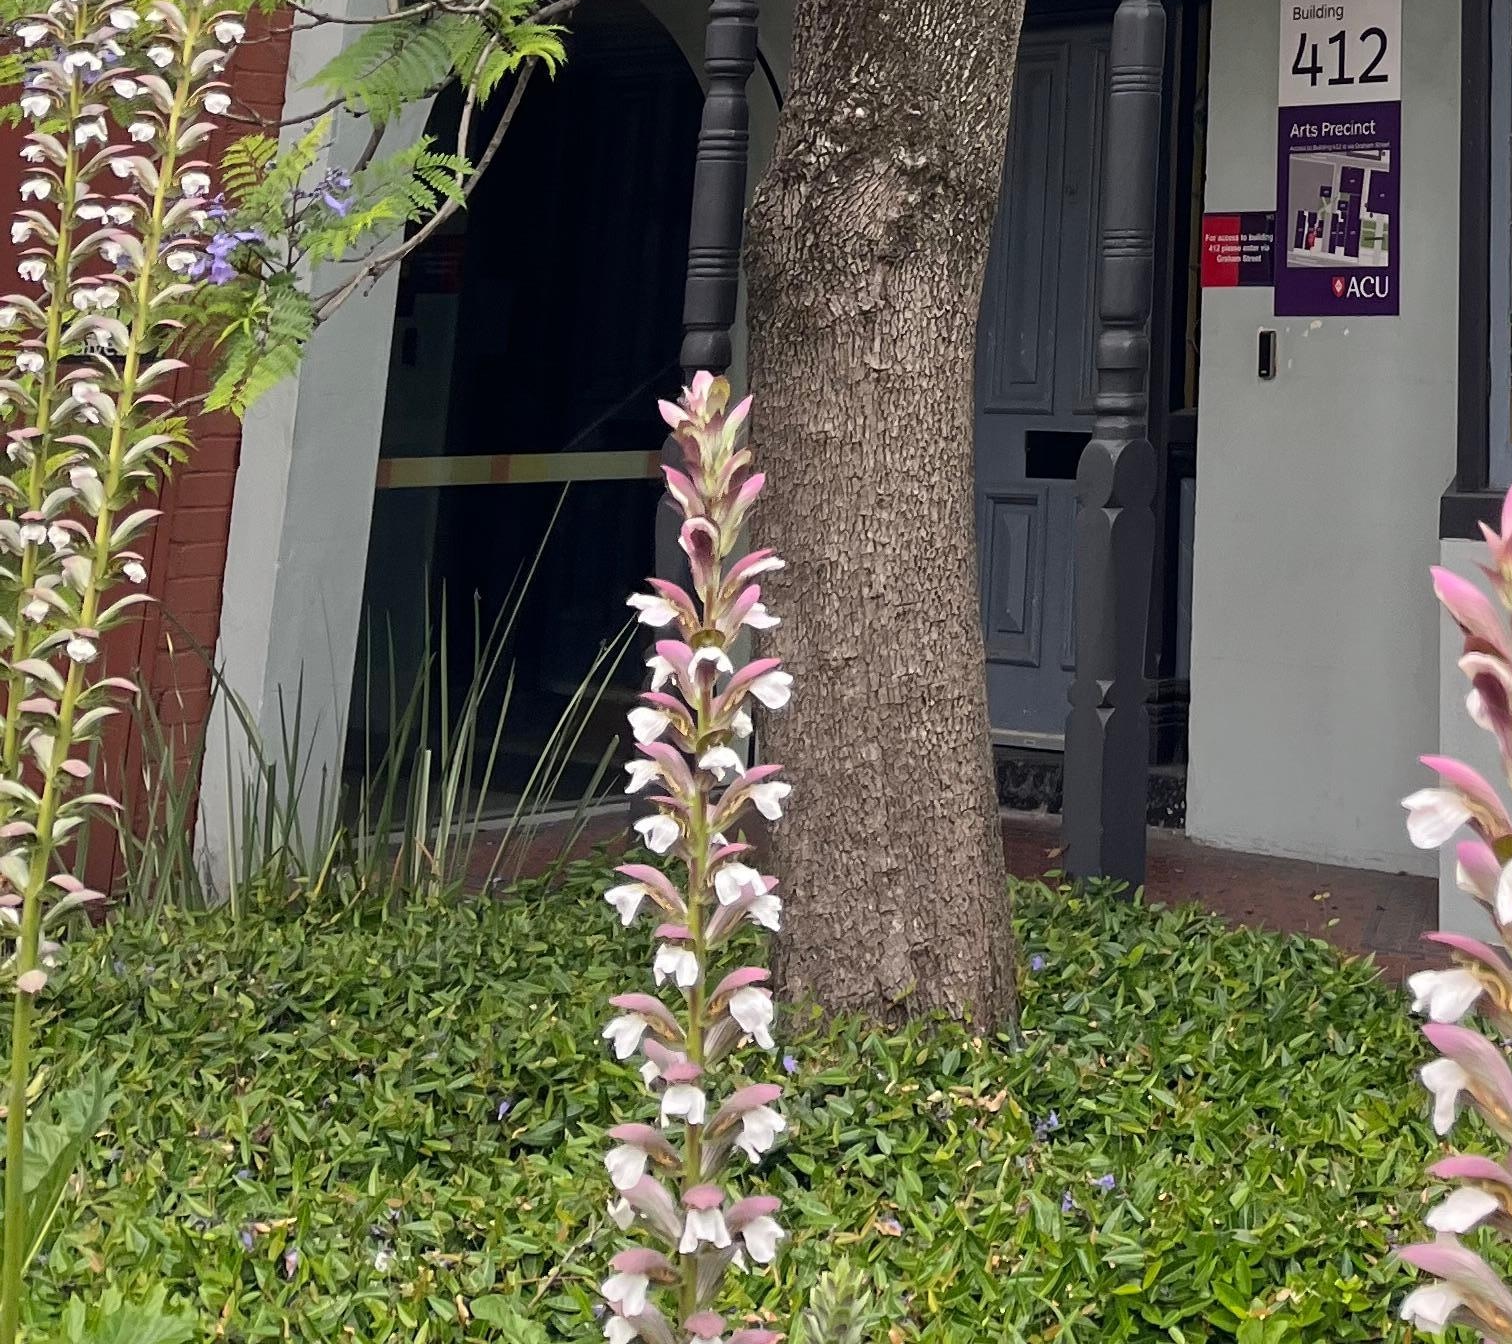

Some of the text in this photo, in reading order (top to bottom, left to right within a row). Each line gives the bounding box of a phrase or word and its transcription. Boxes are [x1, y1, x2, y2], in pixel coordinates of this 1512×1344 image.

[1292, 4, 1344, 21] Building
[1292, 27, 1388, 86] 412
[1290, 120, 1376, 138] Arts Precinct
[1248, 233, 1274, 242] building
[1208, 244, 1220, 252] 412
[1216, 254, 1262, 263] Graham Street
[1346, 275, 1389, 298] ACU
